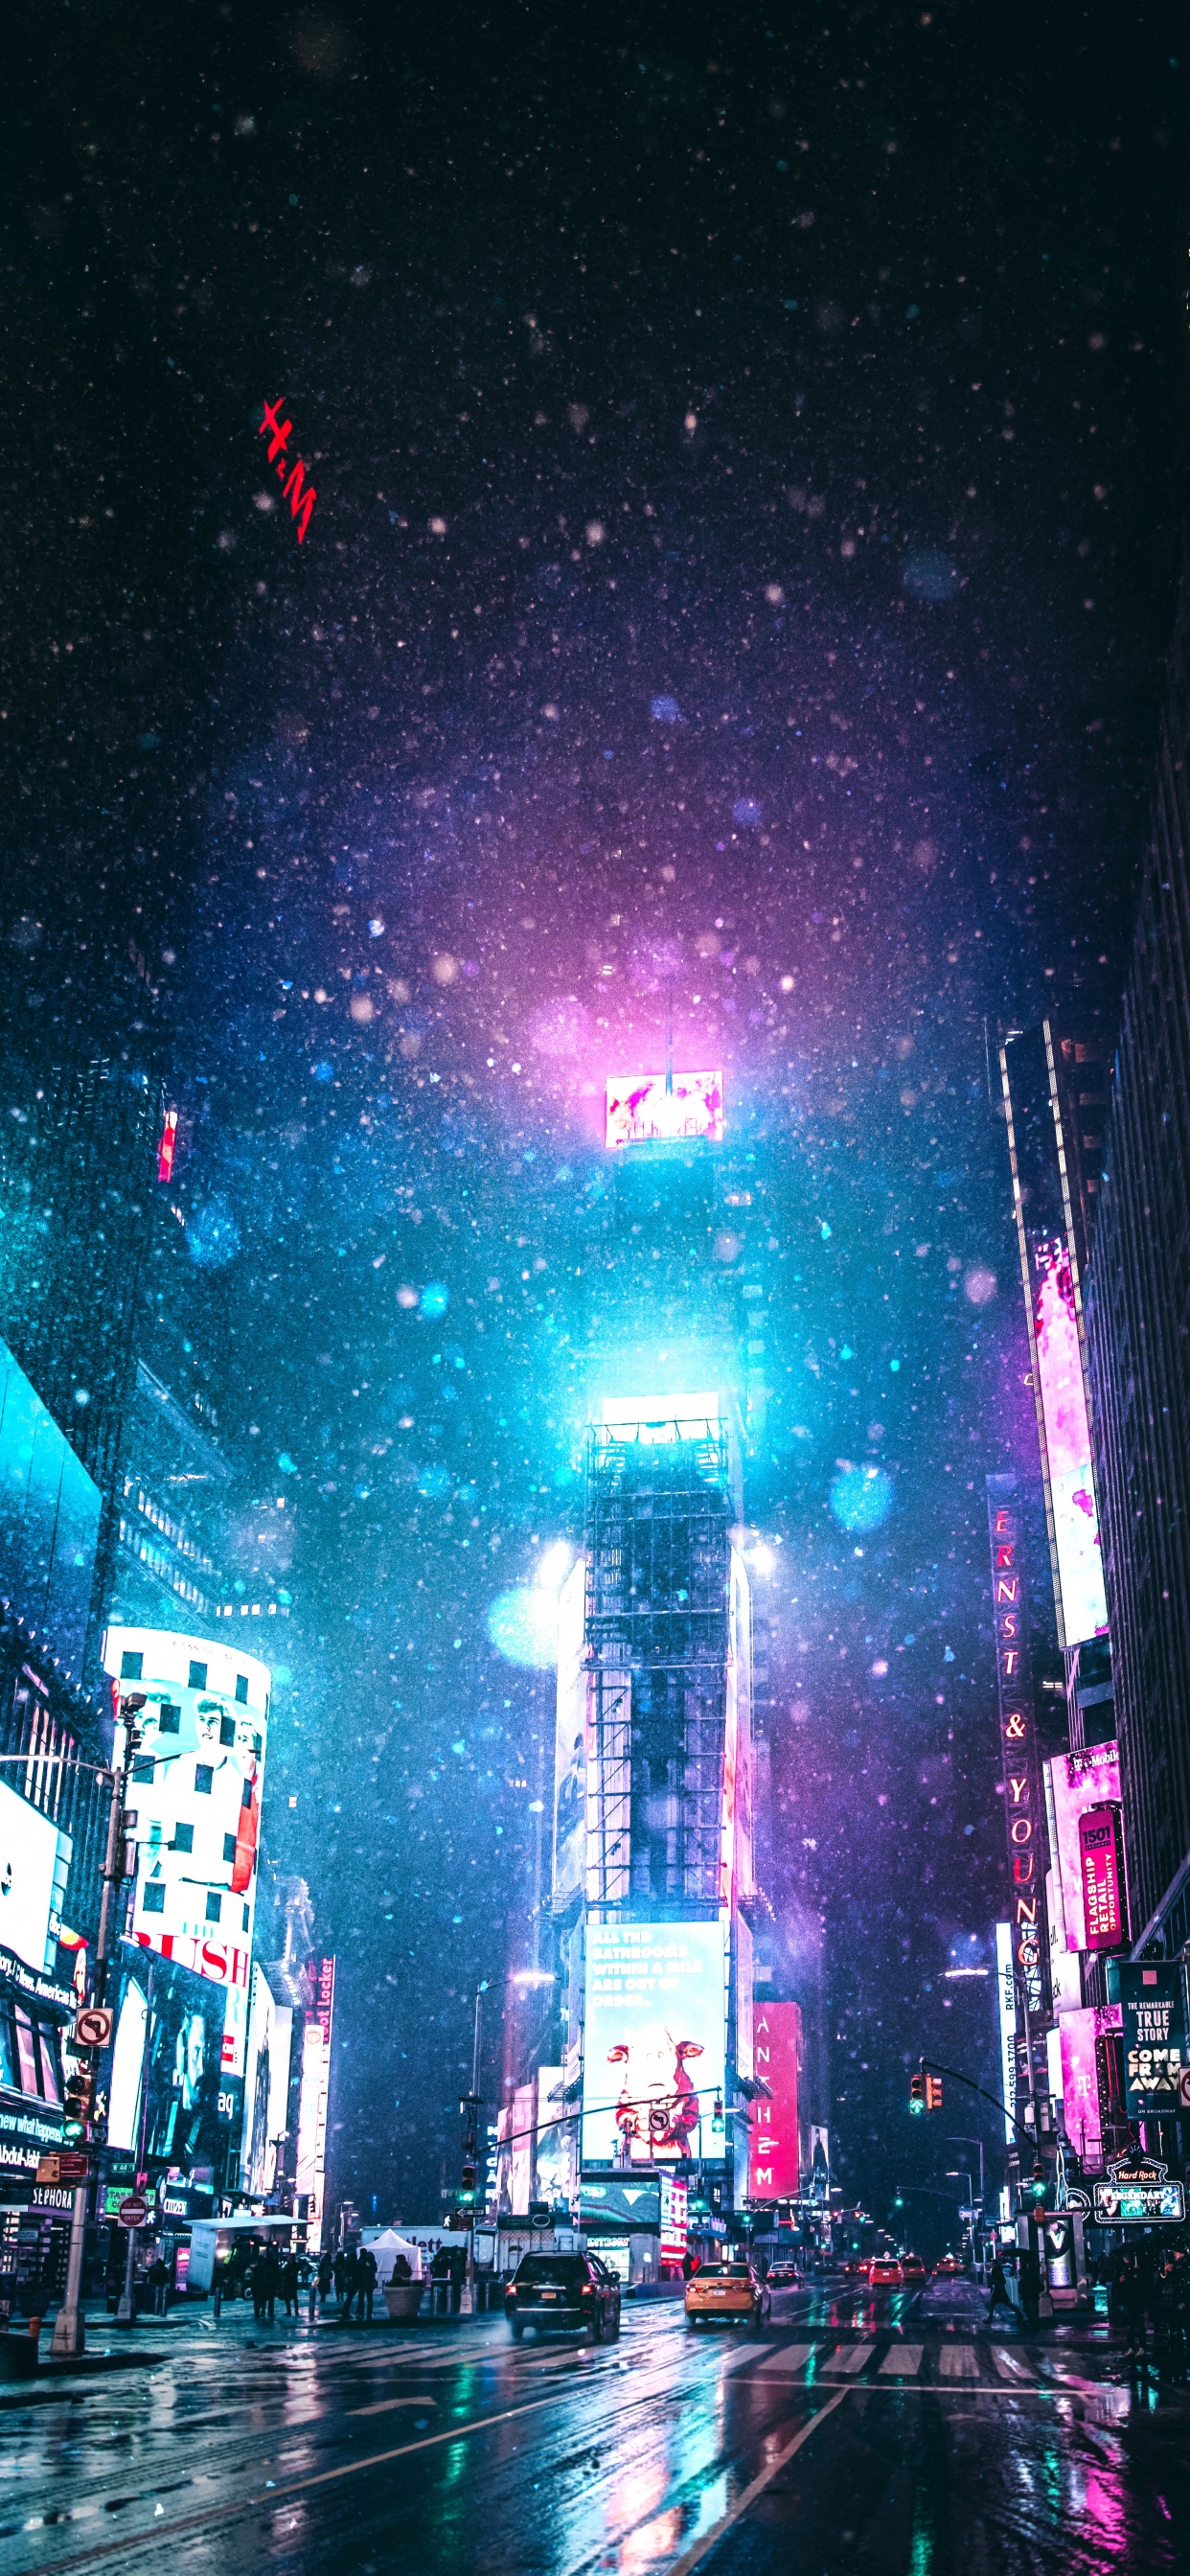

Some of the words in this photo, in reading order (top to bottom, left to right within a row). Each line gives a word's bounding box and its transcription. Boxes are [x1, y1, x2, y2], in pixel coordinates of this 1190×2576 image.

[995, 1509, 1019, 1675] ERNST
[1005, 1713, 1026, 1738] &
[1083, 1826, 1110, 1845] 1501
[1009, 1777, 1040, 1966] YOUNG
[1086, 1856, 1099, 1935] FLAGSHIP
[1105, 1852, 1117, 1931] OPPORTUNITY
[1098, 1878, 1110, 1934] RETAIL
[592, 1931, 620, 1944] ALL
[621, 1930, 652, 1944] THE
[592, 1944, 688, 1960] BATHROOMS
[592, 1962, 649, 1975] WITHIN
[652, 1962, 663, 1974] A
[317, 1958, 333, 2006] Locker
[592, 1978, 622, 1991] ARE
[625, 1977, 655, 1991] OUT
[1004, 1964, 1015, 2011] RKF.com
[1136, 2011, 1170, 2027] TRUE
[1136, 2028, 1169, 2041] STORY
[1128, 2049, 1180, 2063] COME
[1129, 2078, 1179, 2091] AWAY
[17, 2115, 35, 2134] what
[1118, 2171, 1137, 2179] Hard
[1138, 2171, 1157, 2181] Rock
[33, 2188, 72, 2209] SEPHORA
